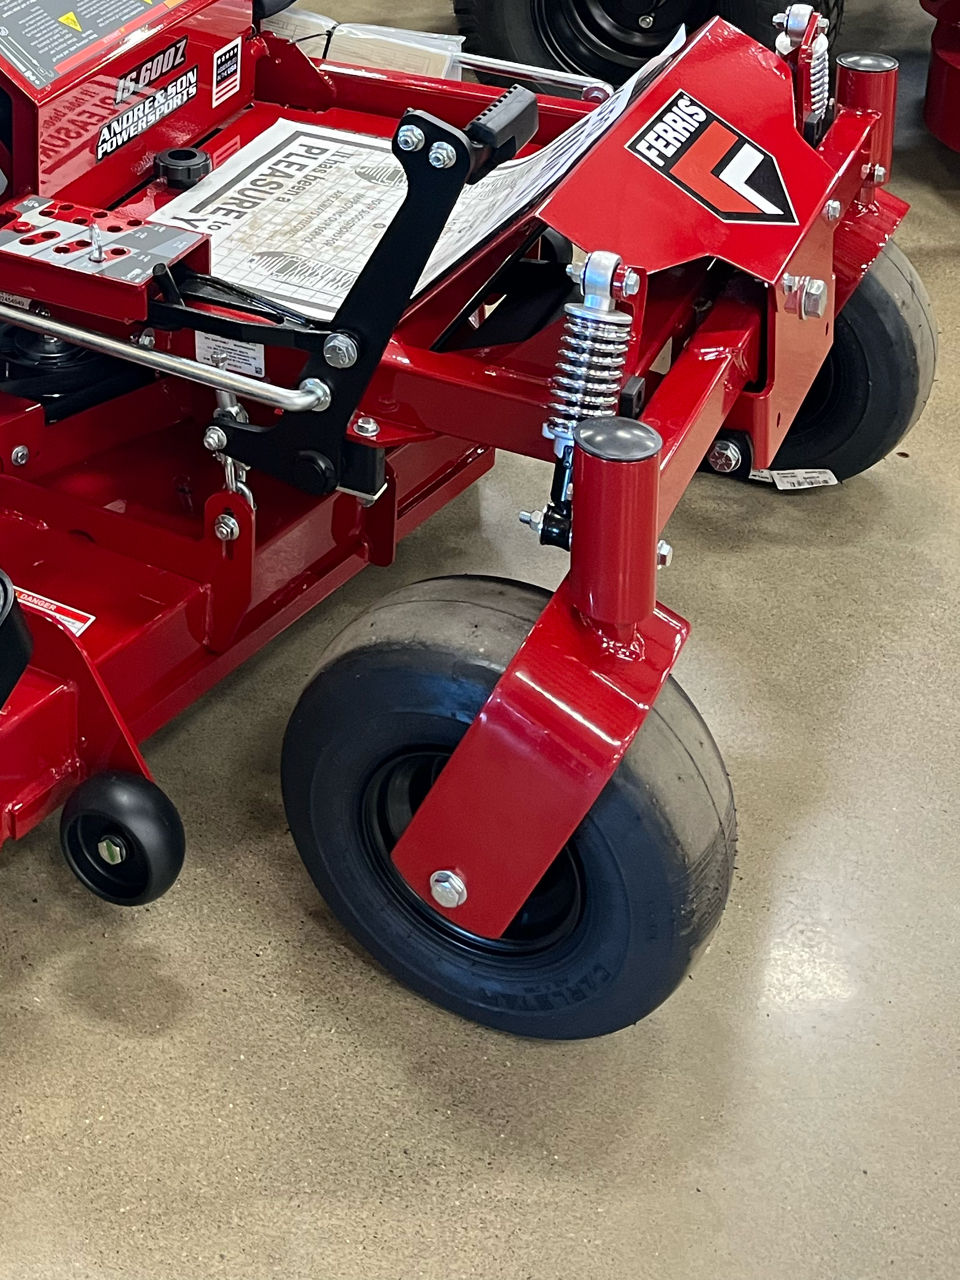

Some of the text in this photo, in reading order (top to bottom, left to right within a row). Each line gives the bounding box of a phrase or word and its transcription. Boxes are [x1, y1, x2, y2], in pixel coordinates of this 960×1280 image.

[97, 83, 197, 160] POWERSPORTS
[635, 97, 707, 167] FERRIS
[332, 148, 353, 159] It
[312, 158, 345, 174] has
[208, 143, 330, 231] PLEASURE to
[284, 174, 326, 196] been
[20, 593, 57, 611] DANGER
